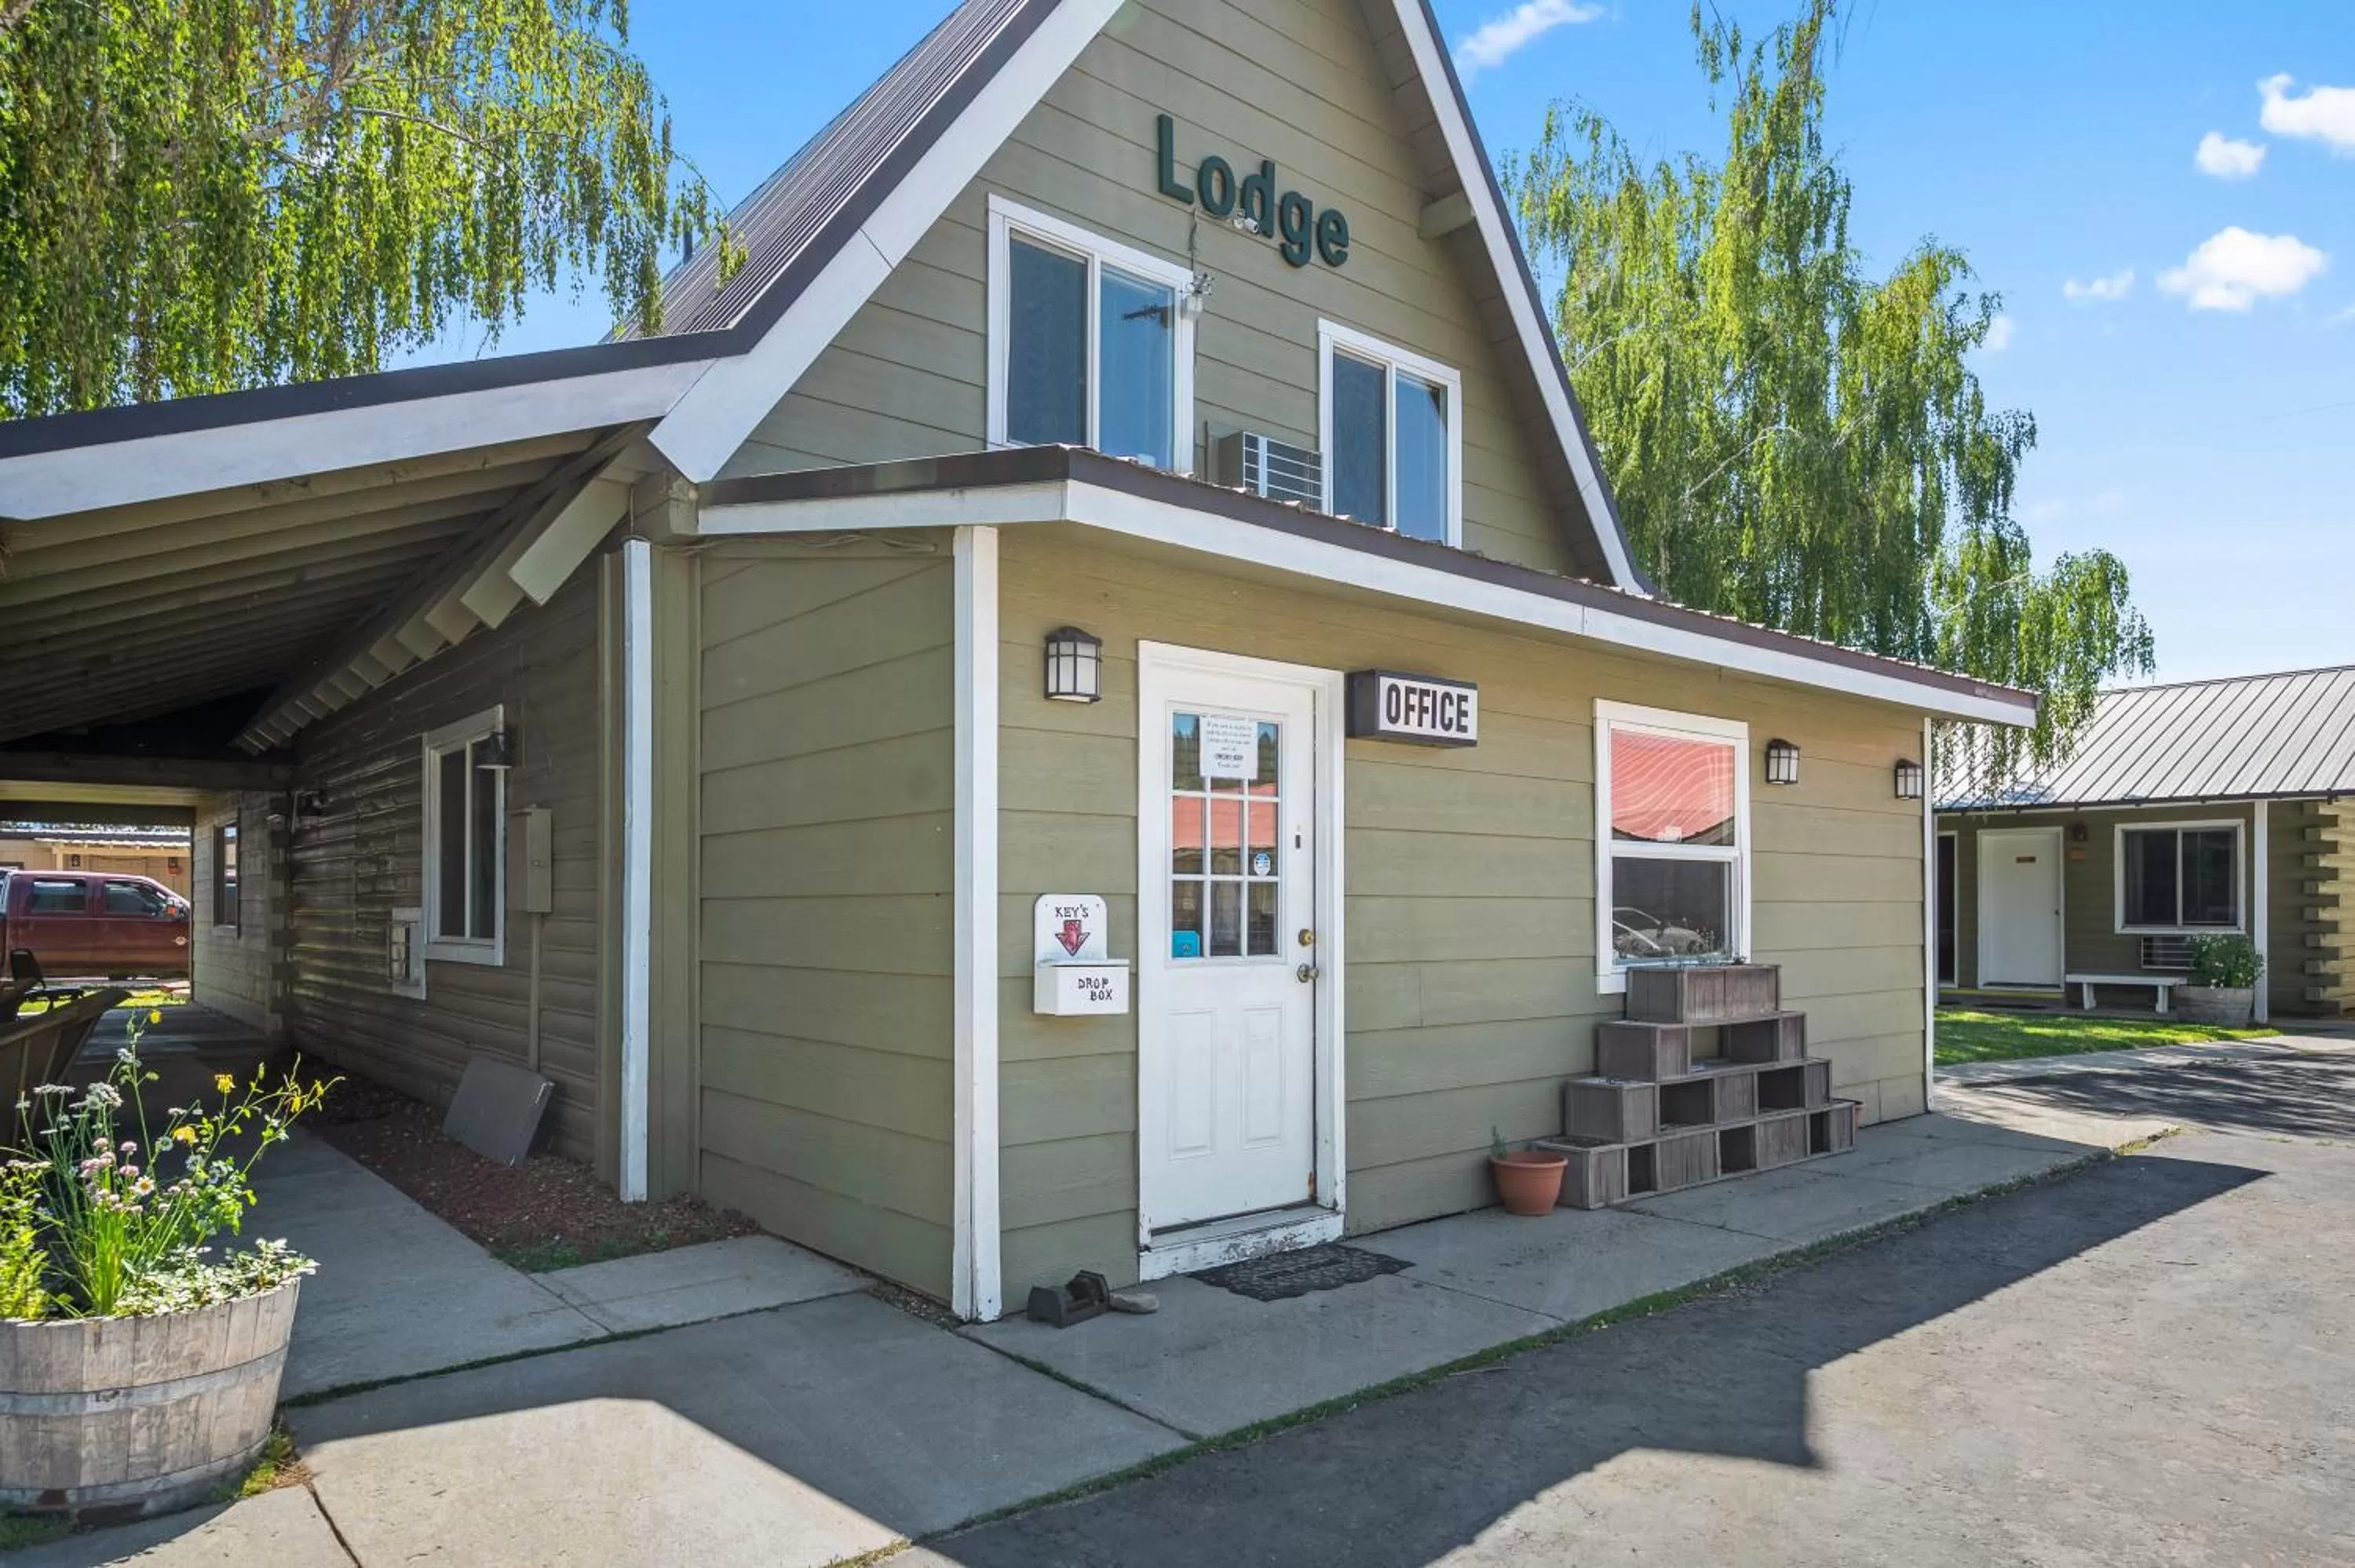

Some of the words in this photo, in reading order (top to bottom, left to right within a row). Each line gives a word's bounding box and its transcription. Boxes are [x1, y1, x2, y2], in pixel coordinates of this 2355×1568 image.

[1157, 114, 1349, 268] Lodge
[1386, 683, 1469, 733] OFFICE
[1055, 904, 1090, 917] KEY'S
[1078, 977, 1109, 989] DROP
[1090, 989, 1112, 1001] BOX
